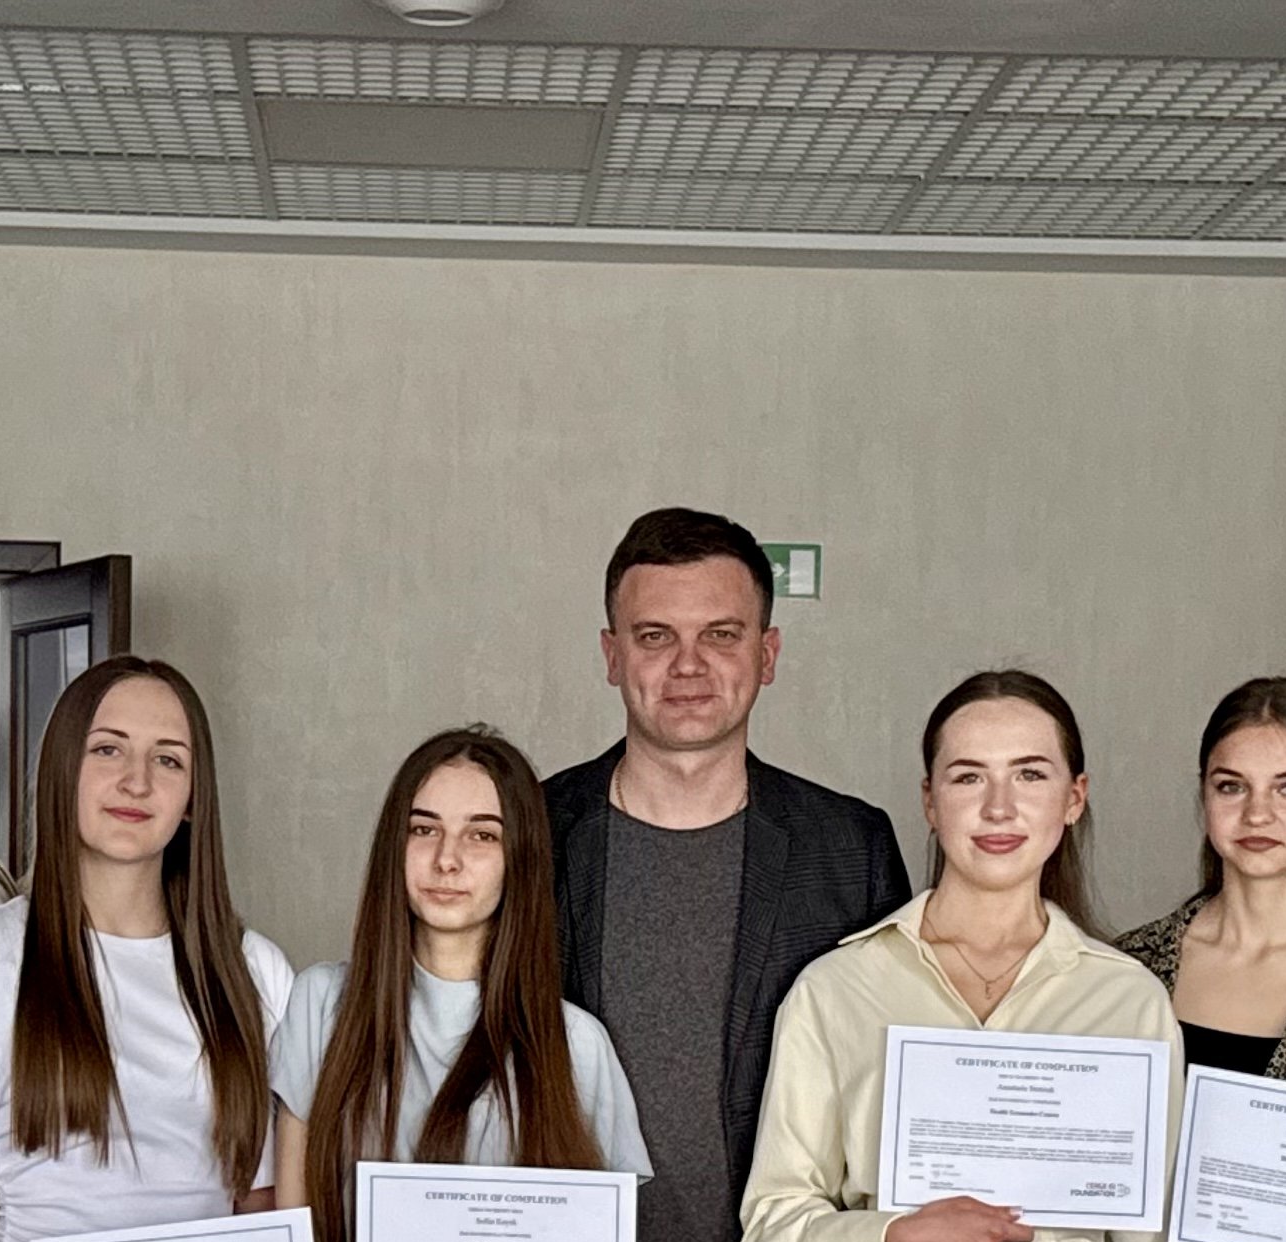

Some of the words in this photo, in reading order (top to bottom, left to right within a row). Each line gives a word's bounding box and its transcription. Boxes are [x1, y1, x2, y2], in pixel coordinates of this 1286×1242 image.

[956, 1058, 1018, 1068] CERTIFICATE
[1020, 1061, 1032, 1069] OF
[1035, 1062, 1098, 1072] COMPLETION
[426, 1191, 487, 1201] CERTIFICATE
[504, 1194, 567, 1204] COMPLETION
[1070, 1188, 1115, 1197] FOUNDATION
